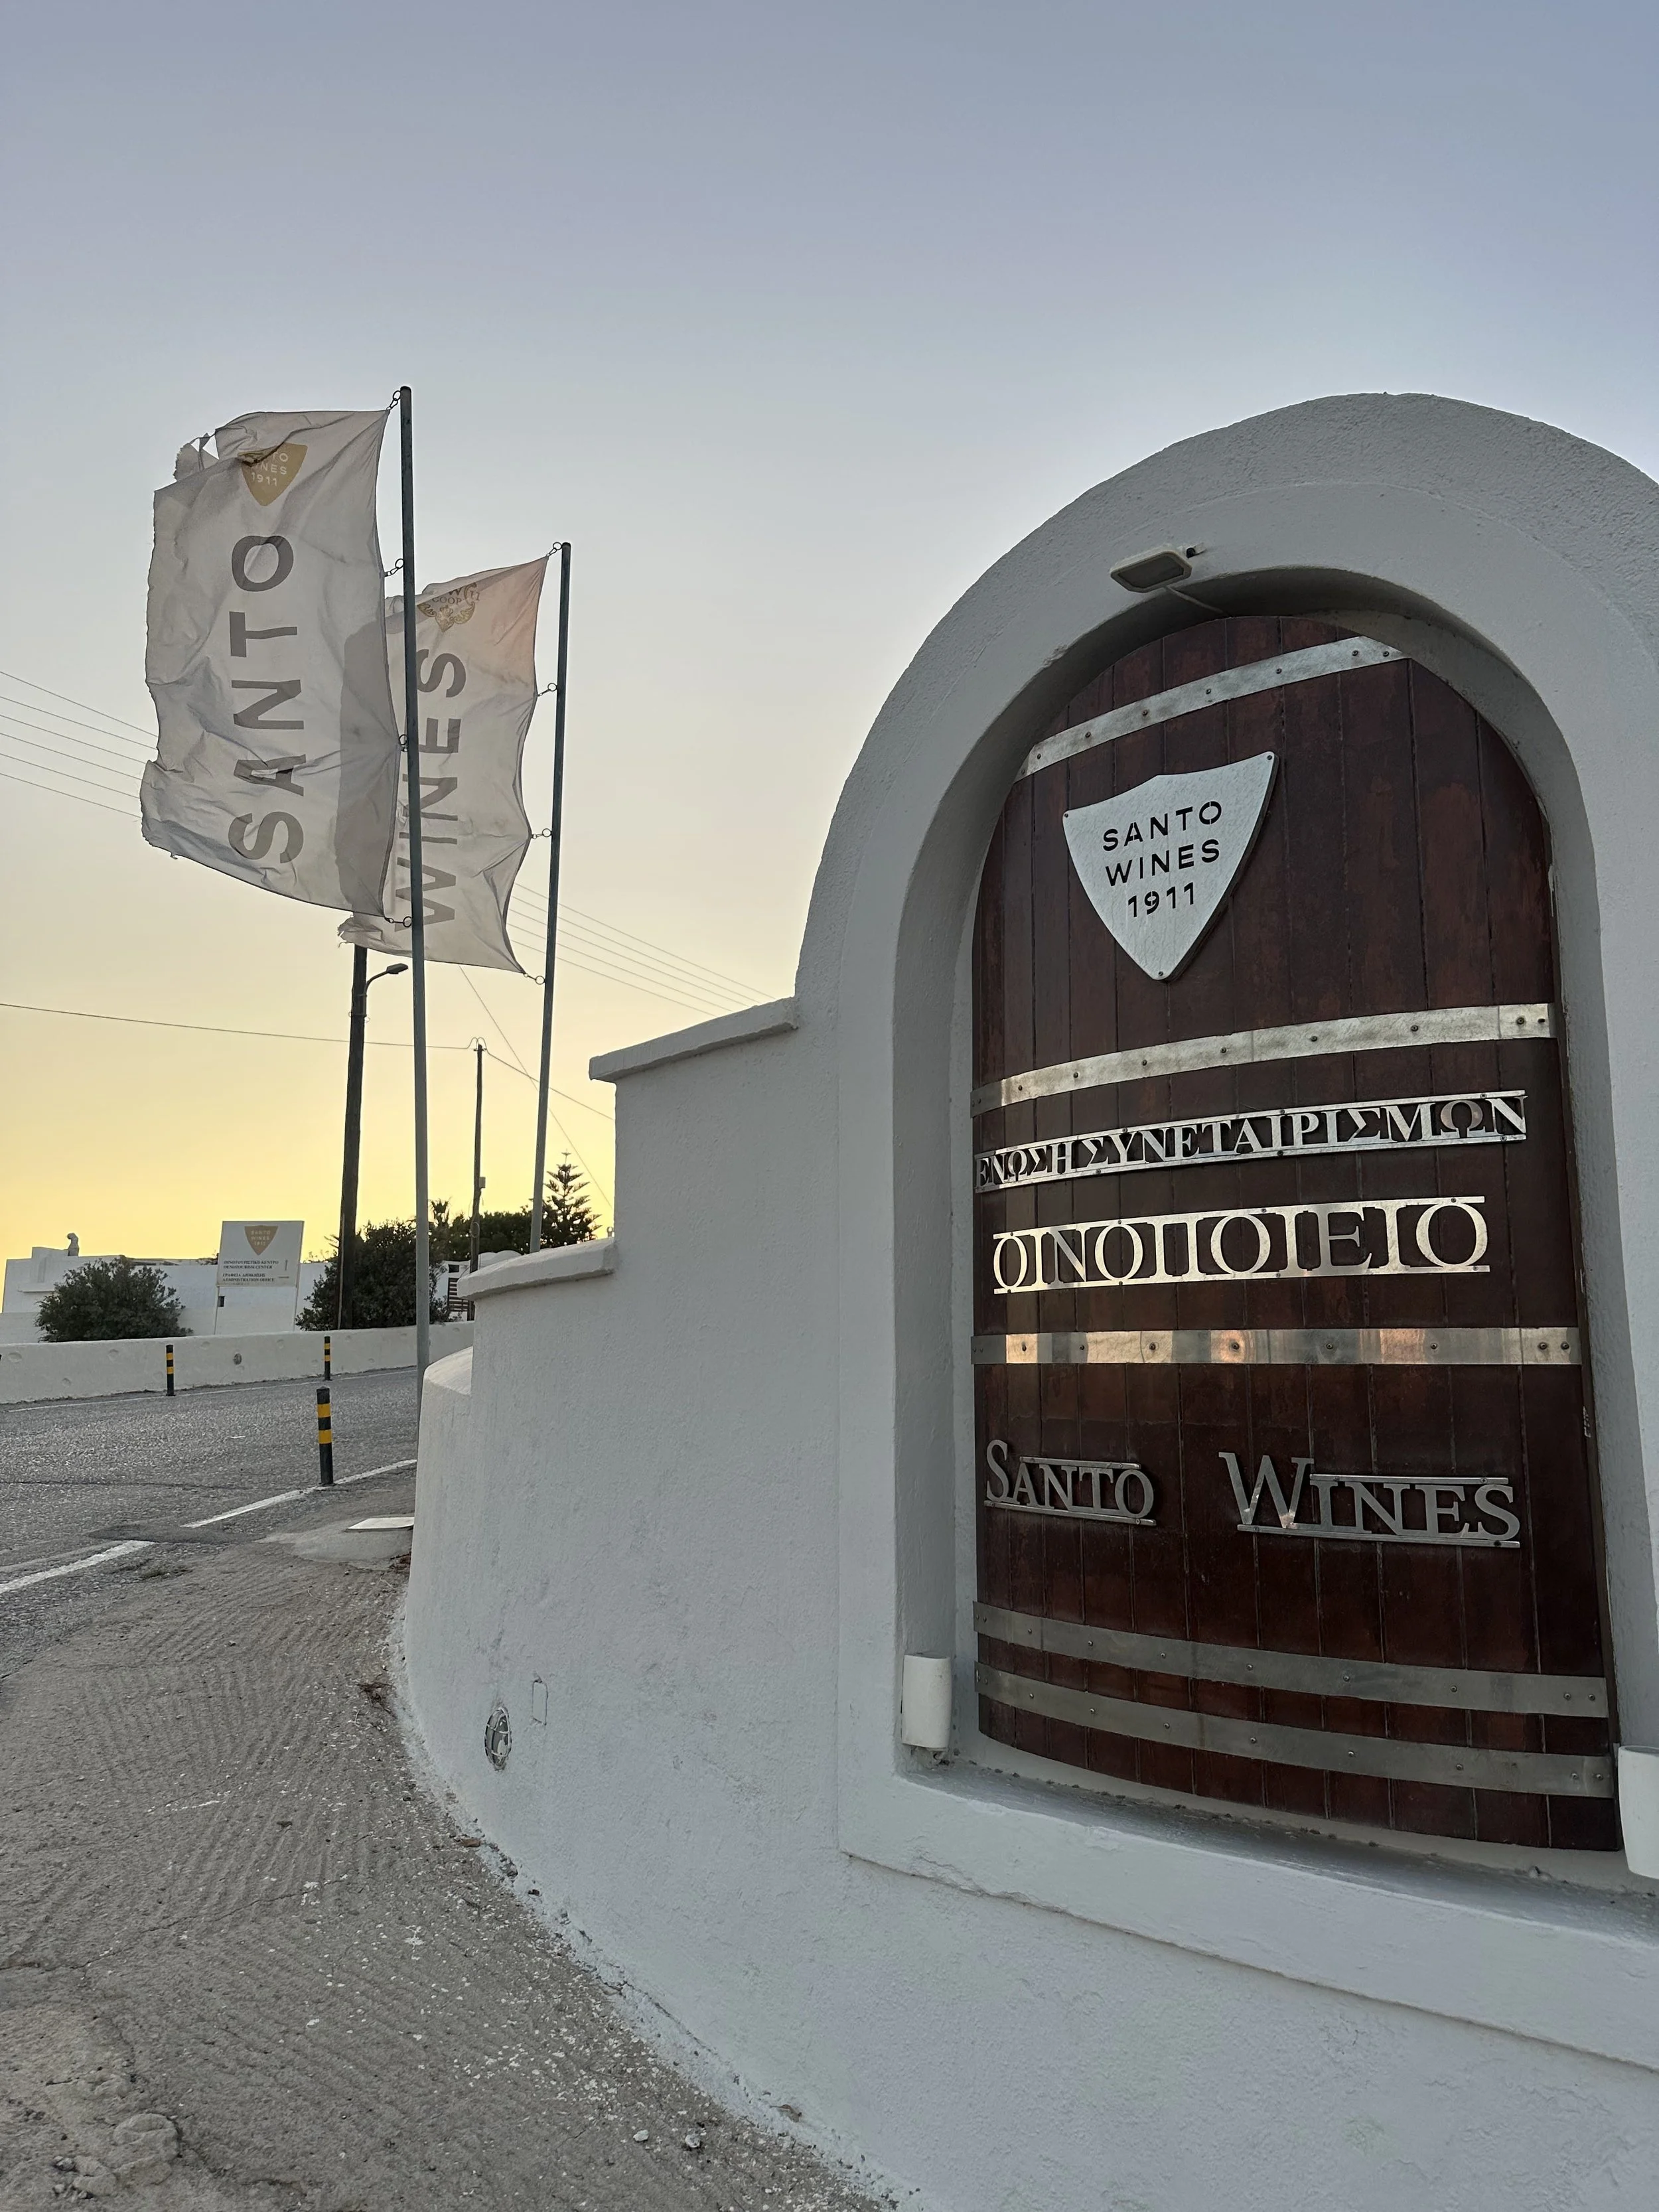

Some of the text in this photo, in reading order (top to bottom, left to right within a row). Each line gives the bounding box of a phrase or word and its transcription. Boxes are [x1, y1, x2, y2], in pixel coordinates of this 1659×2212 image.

[251, 471, 277, 486] 1911
[228, 535, 307, 864] SANTO
[394, 648, 467, 932] WINES
[1102, 800, 1222, 851] SANTO
[1105, 838, 1220, 887] WINES
[1127, 881, 1195, 918] 1911
[976, 1095, 1528, 1188] ΕΝΩΣΗ ΣΥΝΕΤΑΙΡΙΣΜΩΝ
[993, 1199, 1489, 1292] ΟΙΝΟΠΟΙΕΙΟ
[985, 1439, 1520, 1541] SANTO WINES
